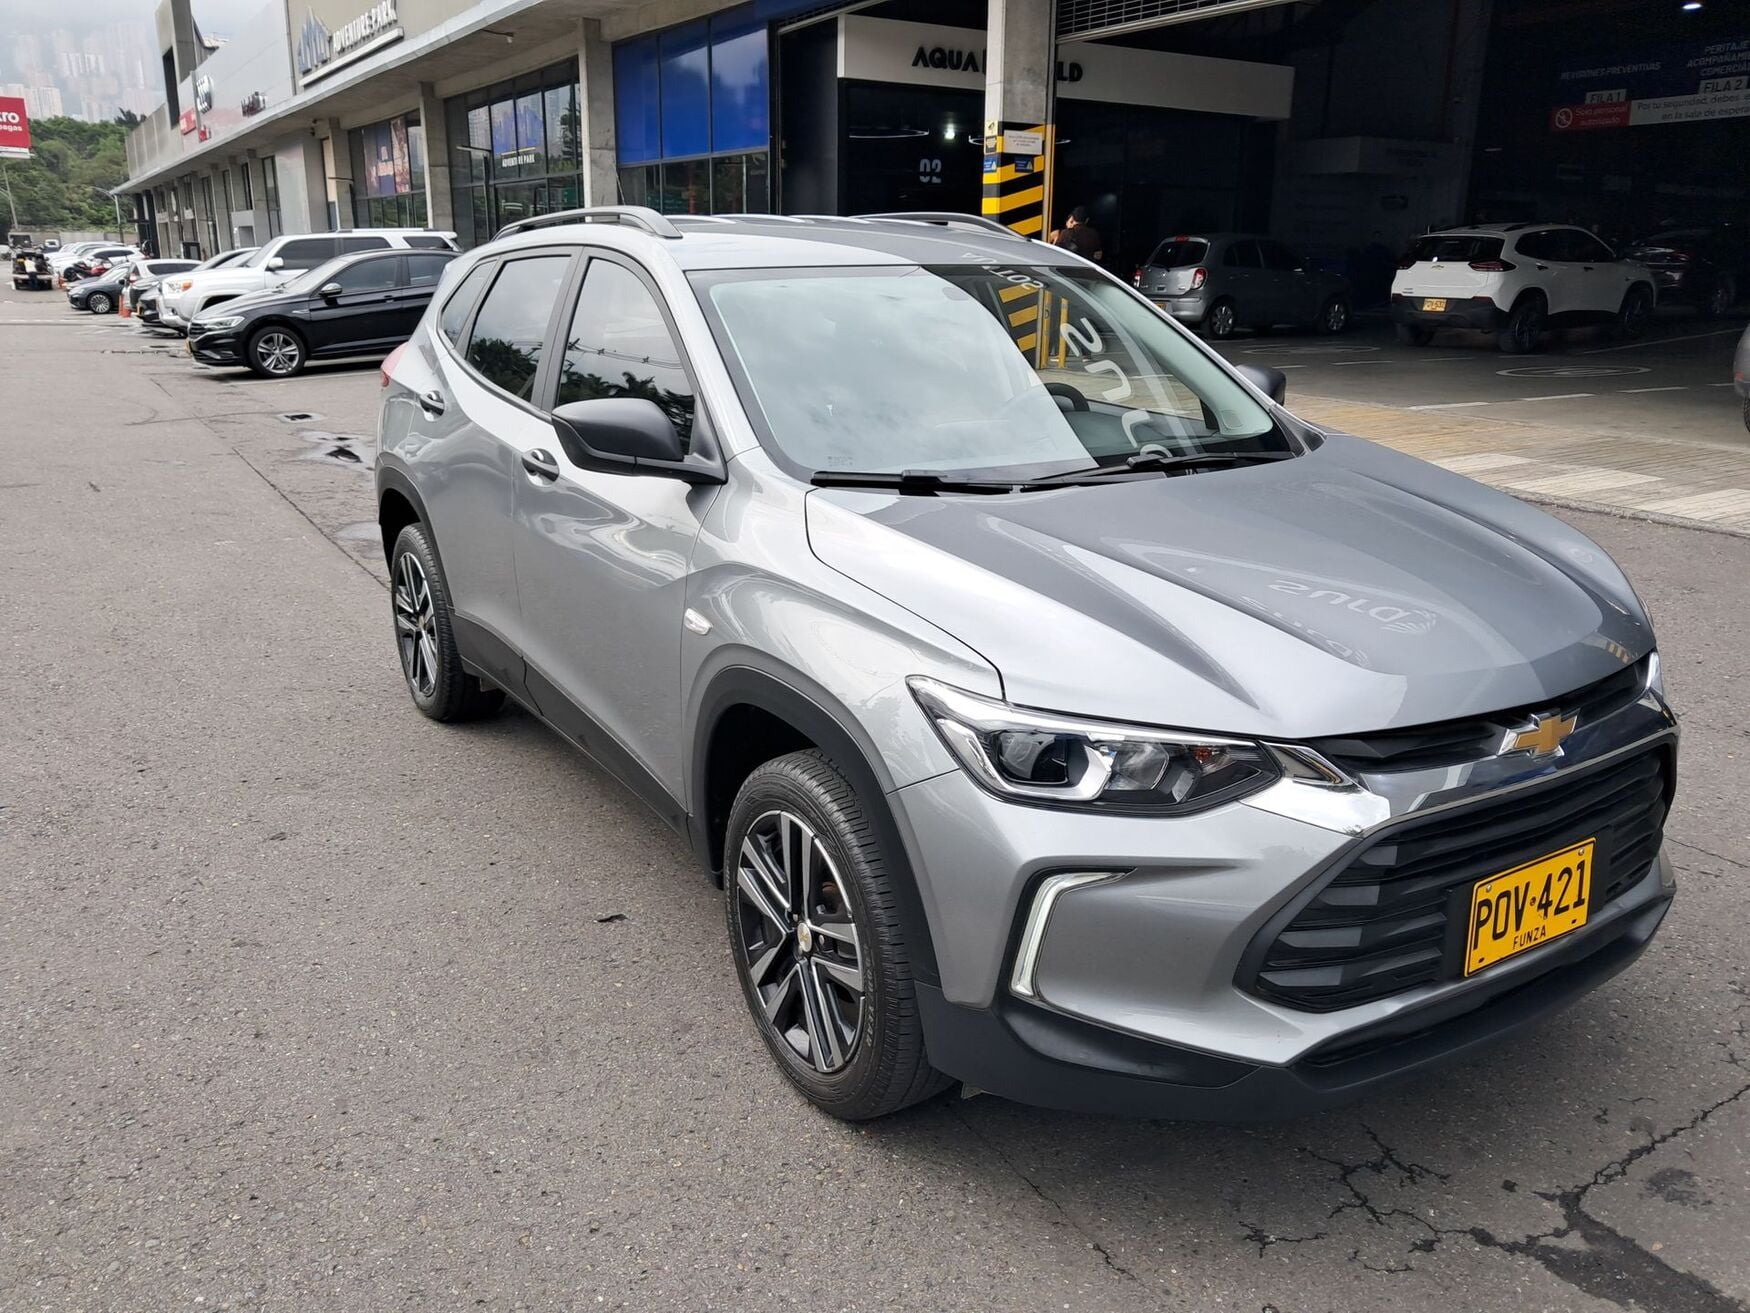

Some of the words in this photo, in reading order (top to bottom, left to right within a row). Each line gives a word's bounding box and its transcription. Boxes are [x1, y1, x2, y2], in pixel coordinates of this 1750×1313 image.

[912, 46, 979, 72] AQUA
[1704, 81, 1732, 93] FILA
[1734, 79, 1743, 91] 2
[919, 158, 942, 183] 02
[1513, 924, 1547, 950] FUNZA
